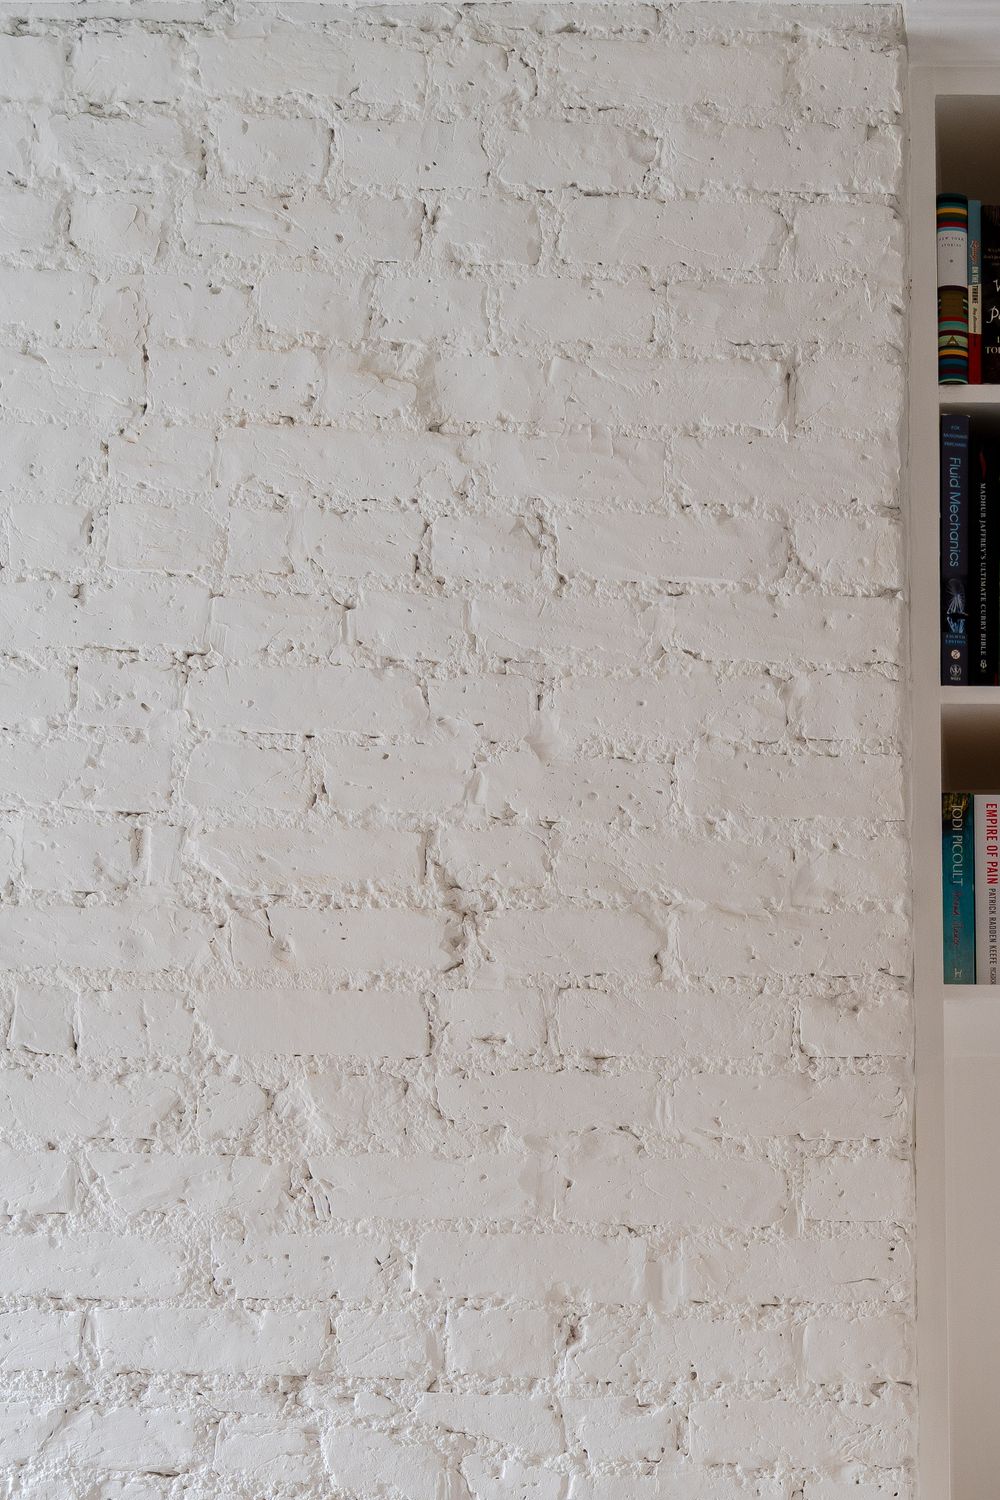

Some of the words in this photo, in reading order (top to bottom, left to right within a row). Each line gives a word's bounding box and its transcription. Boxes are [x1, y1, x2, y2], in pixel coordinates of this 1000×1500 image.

[949, 457, 961, 489] Fluid
[949, 492, 961, 567] Mechanics
[986, 803, 997, 841] EMPIRE
[986, 845, 998, 857] OF
[987, 861, 998, 884] PAIN
